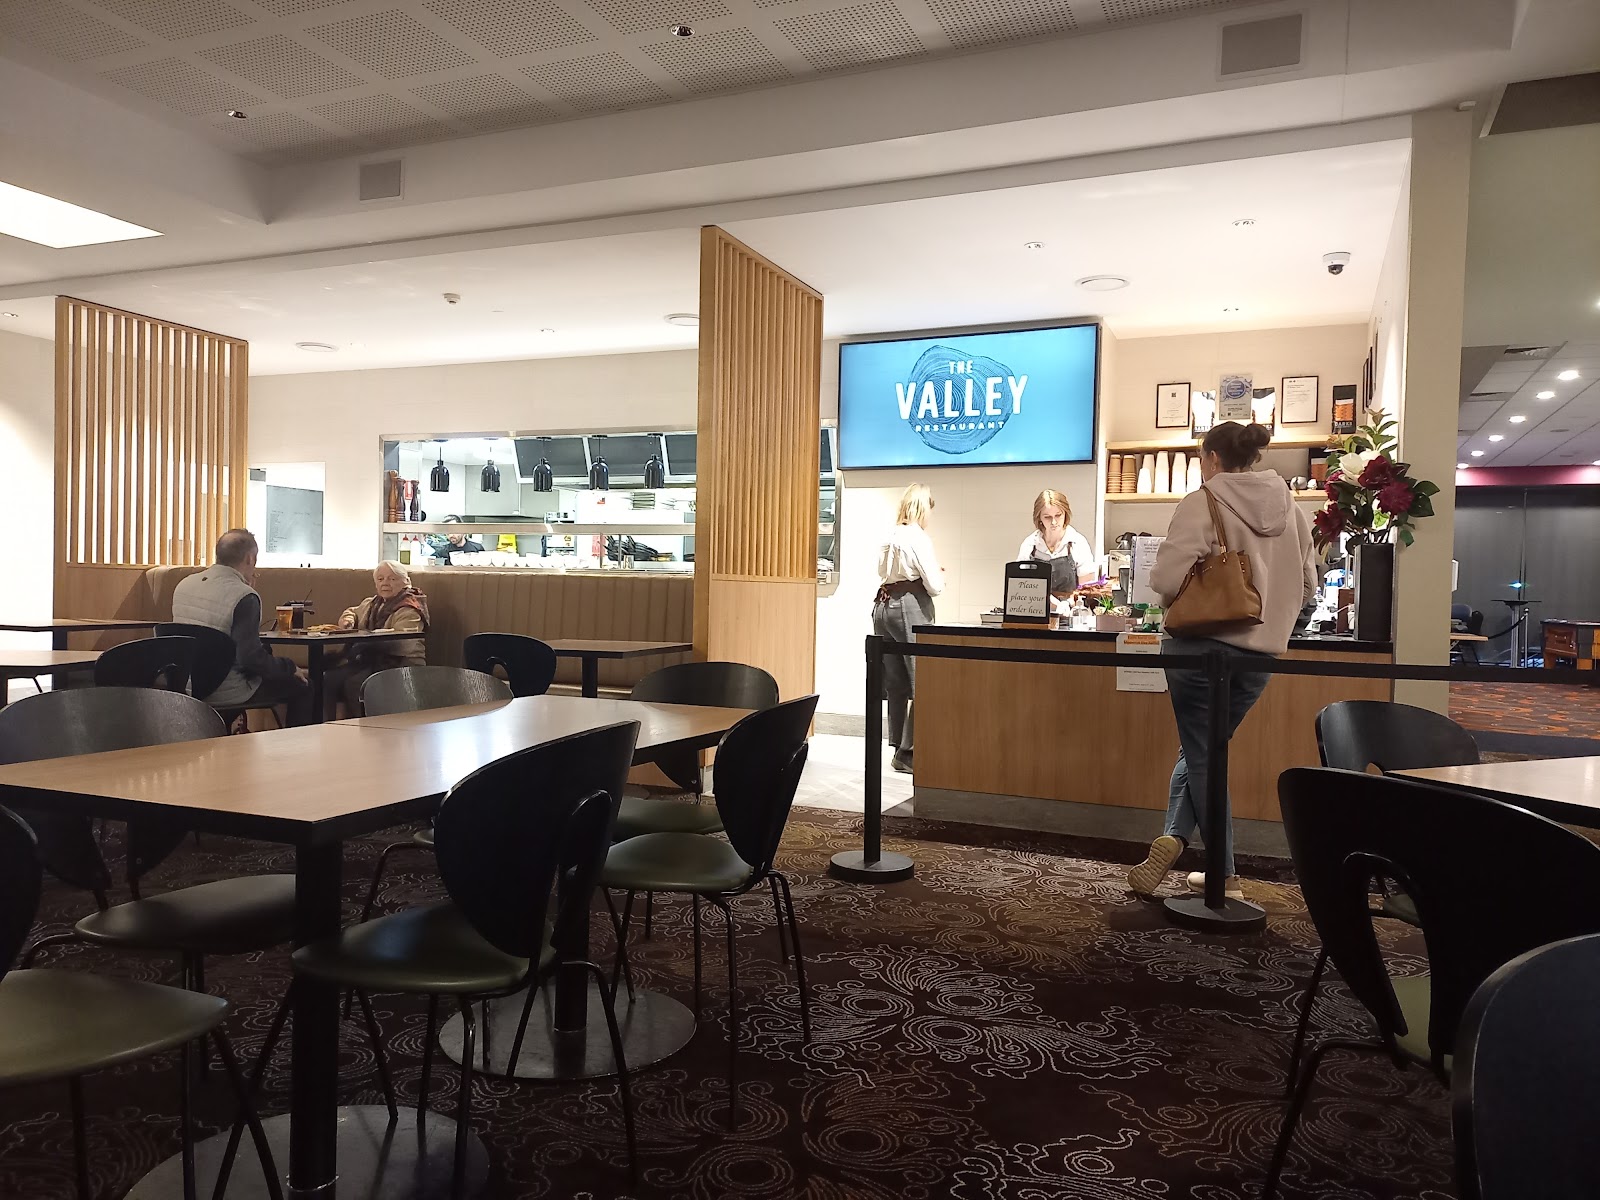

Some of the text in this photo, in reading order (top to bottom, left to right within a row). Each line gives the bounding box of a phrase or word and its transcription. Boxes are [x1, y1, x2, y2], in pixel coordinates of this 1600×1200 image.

[948, 360, 974, 374] THE
[895, 375, 1028, 419] VALLEY
[915, 421, 1005, 433] RESTAURANT
[1018, 580, 1039, 589] Please
[1009, 592, 1045, 604] place your
[1009, 605, 1044, 614] order here.
